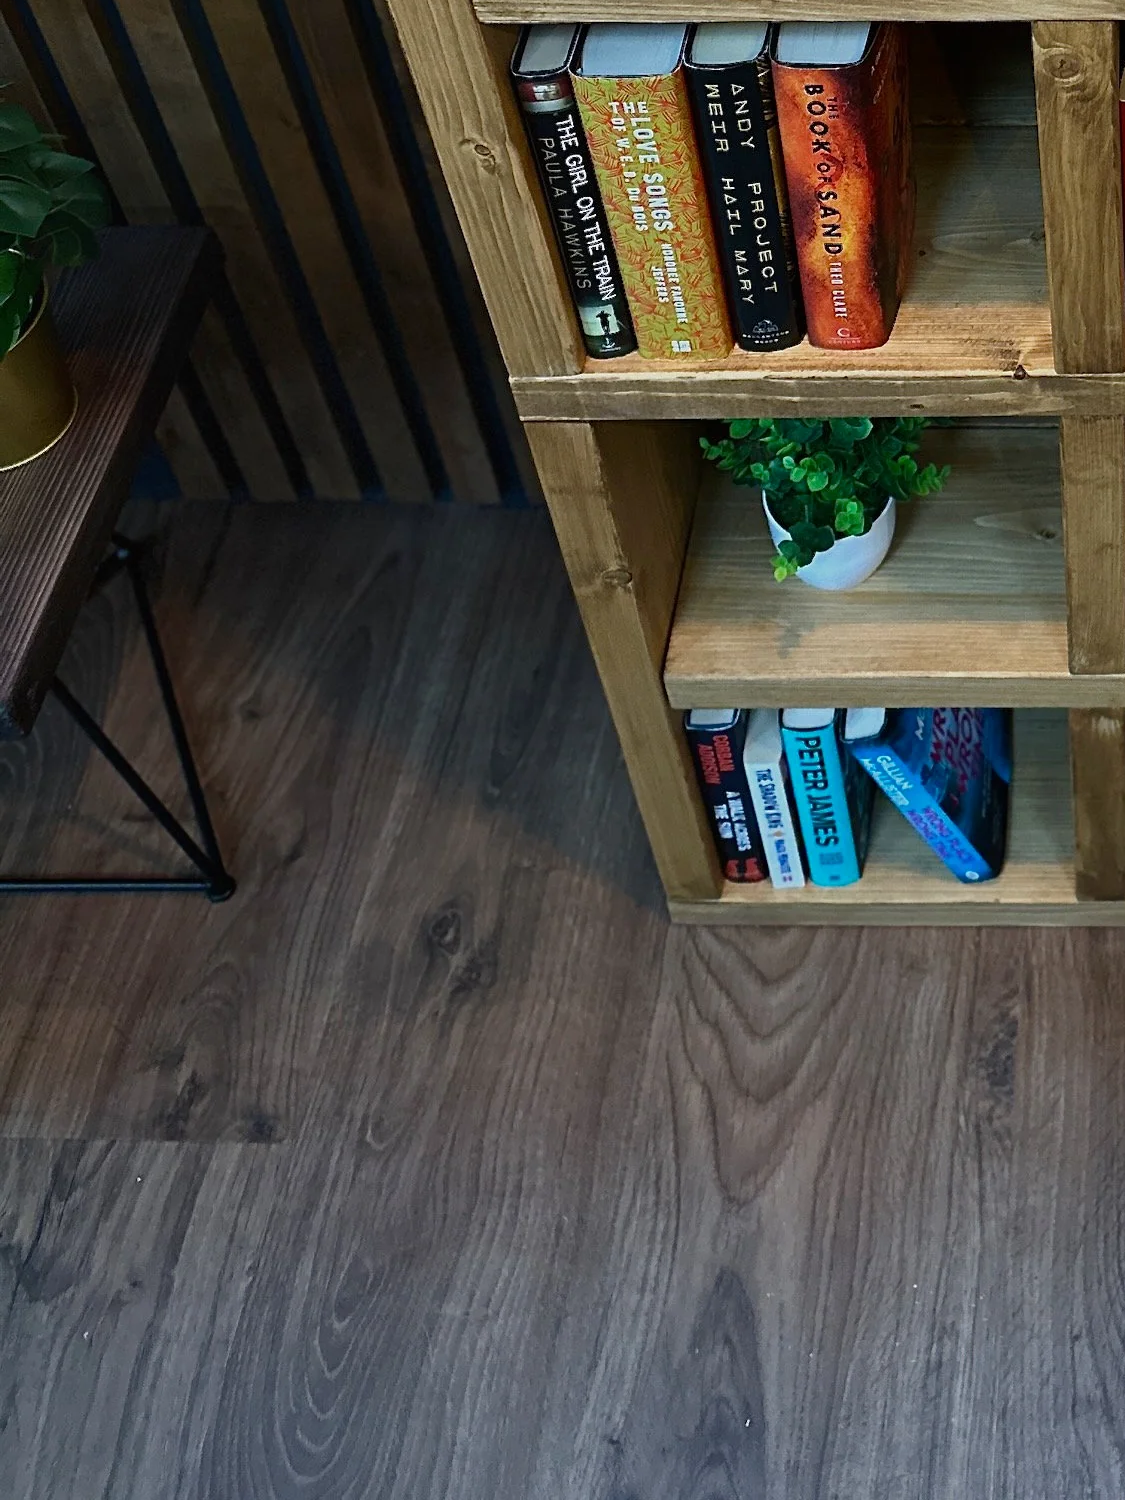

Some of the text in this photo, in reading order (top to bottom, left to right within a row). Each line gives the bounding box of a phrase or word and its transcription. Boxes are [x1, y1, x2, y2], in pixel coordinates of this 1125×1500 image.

[610, 117, 627, 132] OF
[703, 83, 730, 153] WEIR
[730, 82, 755, 149] ANDY
[803, 83, 832, 154] BOOK
[826, 95, 840, 120] THE
[607, 101, 675, 232] THE LOVE SONGS
[538, 137, 568, 198] PAULA
[557, 208, 592, 289] HAWKINS
[555, 113, 617, 301] THE GIRL ON THE TRAIN
[747, 181, 778, 293] PROJECT
[817, 190, 844, 255] SAND
[721, 177, 755, 305] HAIL MARY
[829, 261, 848, 319] THEO CLARE
[697, 743, 721, 785] ADDISON
[712, 734, 736, 772] CORBAN
[794, 735, 829, 791] PETER
[876, 754, 915, 791] GILLIAN
[807, 794, 840, 848] JAMES
